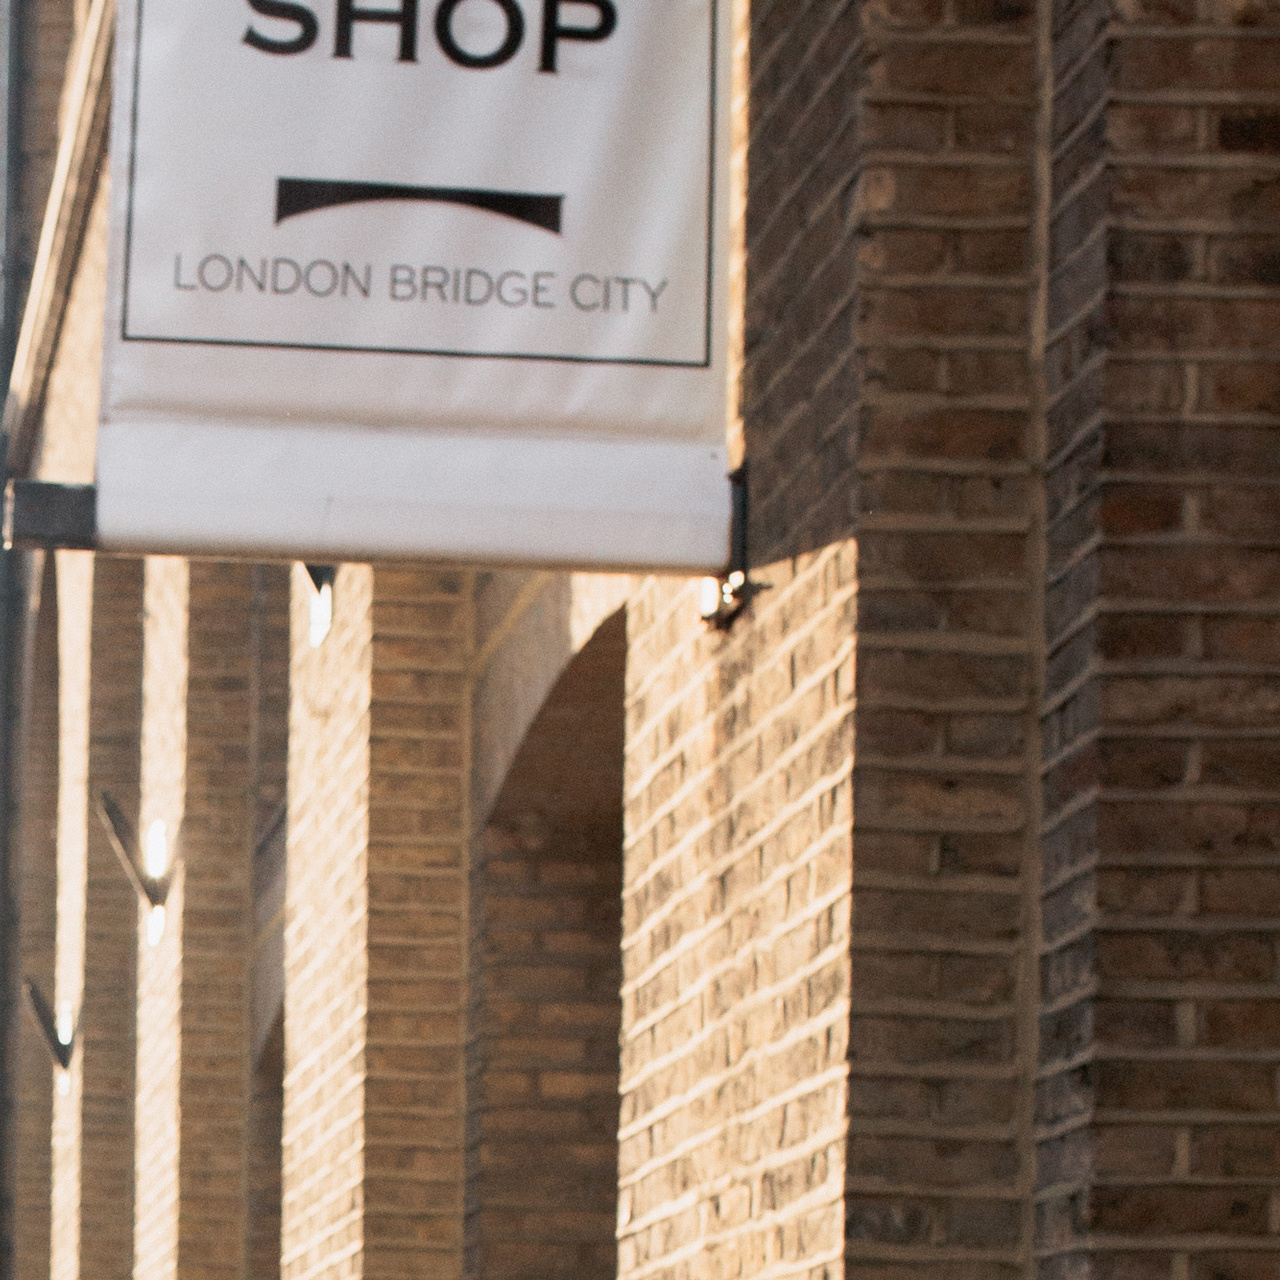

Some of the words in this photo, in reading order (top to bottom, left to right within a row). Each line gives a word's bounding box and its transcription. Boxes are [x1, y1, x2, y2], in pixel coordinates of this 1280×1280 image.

[242, 0, 618, 74] SHOP
[173, 253, 372, 299] LONDON
[389, 264, 556, 310] BRIDGE
[569, 273, 670, 313] CITY
